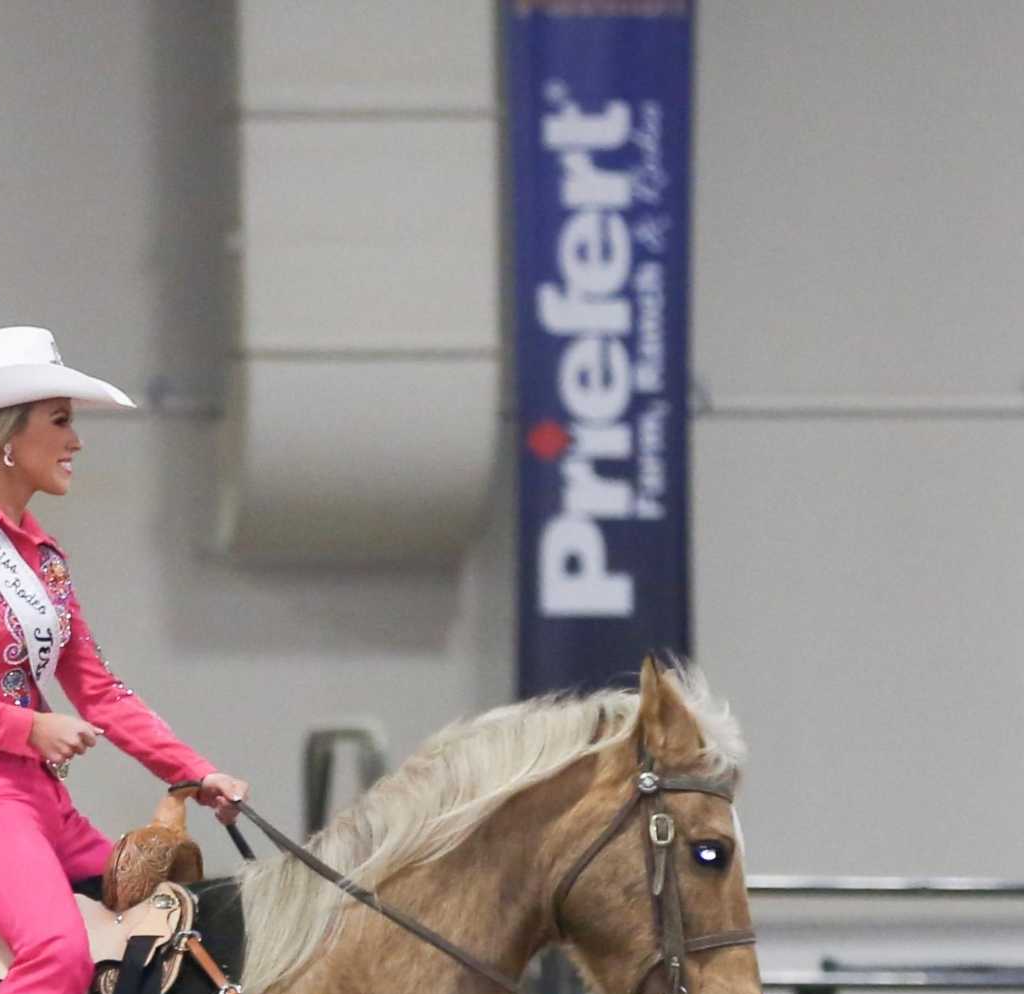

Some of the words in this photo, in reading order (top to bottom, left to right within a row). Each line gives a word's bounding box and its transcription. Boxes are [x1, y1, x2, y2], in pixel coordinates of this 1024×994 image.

[527, 97, 633, 617] Priefert
[635, 261, 665, 393] Ranch
[5, 578, 47, 615] Rodeo
